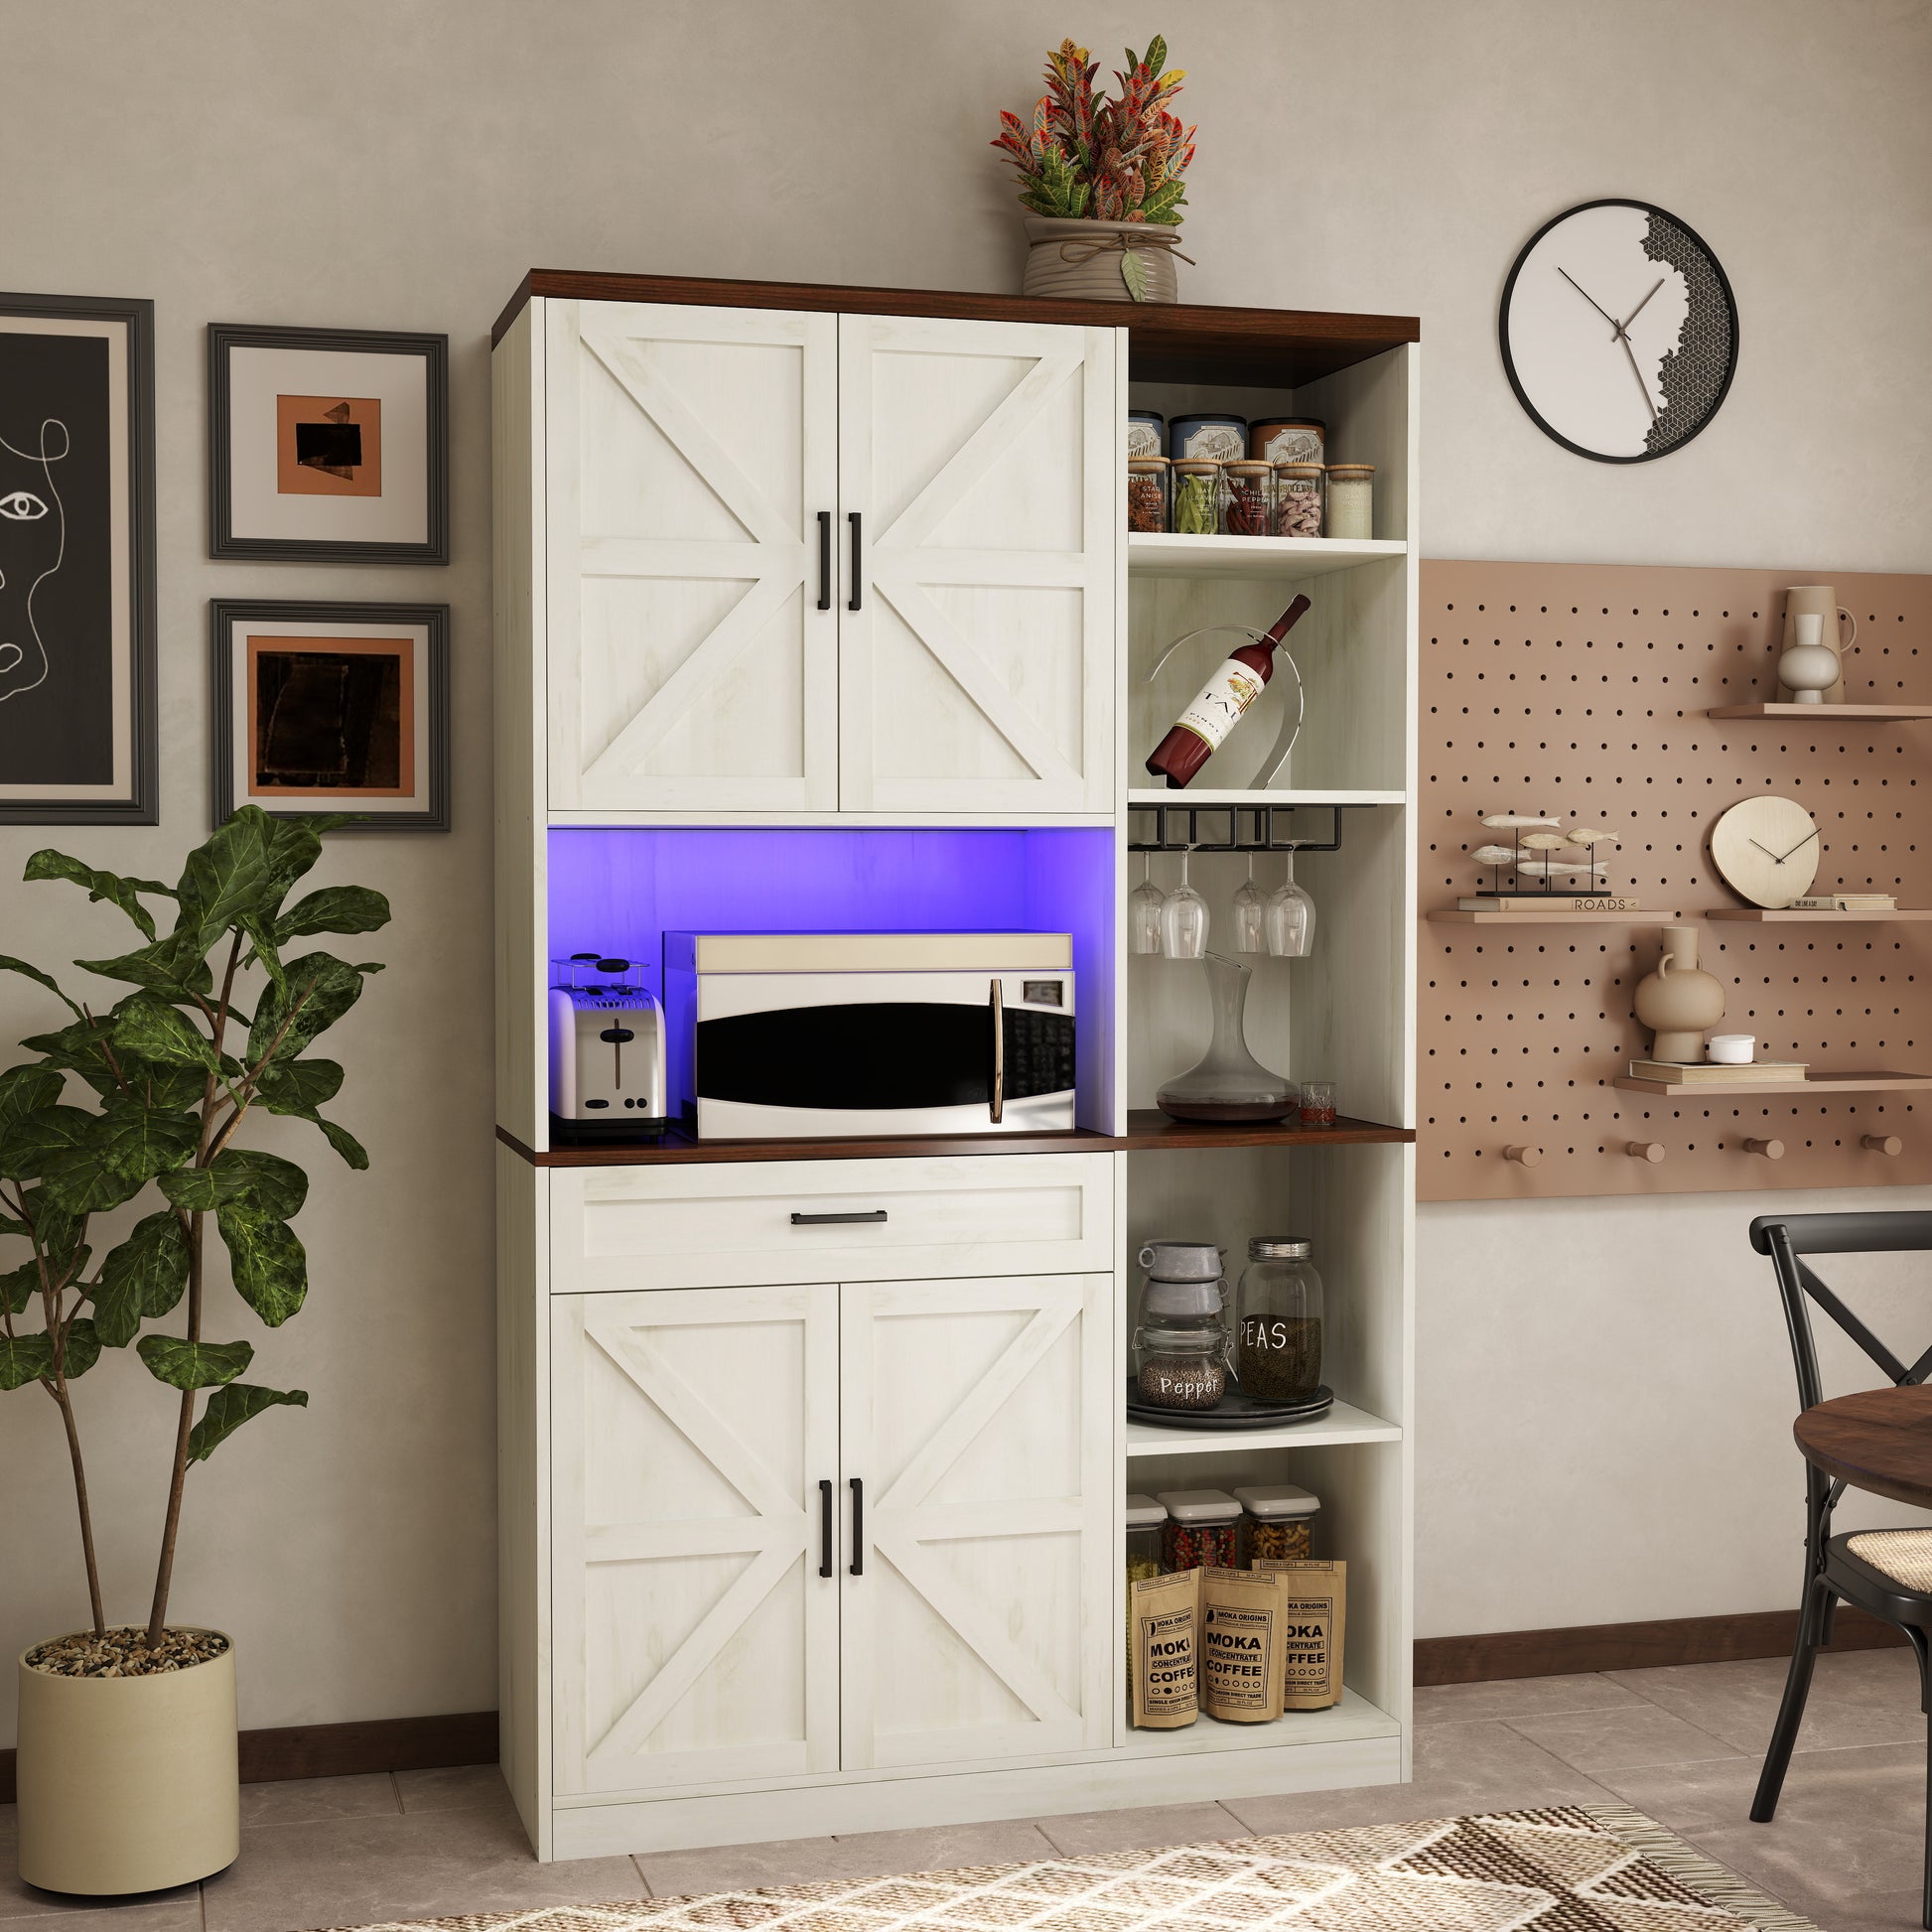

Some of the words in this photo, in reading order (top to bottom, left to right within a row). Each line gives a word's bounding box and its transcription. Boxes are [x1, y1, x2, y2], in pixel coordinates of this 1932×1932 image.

[1575, 898, 1626, 910] ROADS
[1240, 1320, 1287, 1349] PEAS
[1161, 1377, 1218, 1400] Pepper
[1218, 1610, 1238, 1620] MOKA
[1238, 1613, 1268, 1622] ORIGINS
[1287, 1624, 1323, 1638] OKA
[1206, 1631, 1262, 1650] MOKA
[1152, 1654, 1191, 1669] CONCENTRA
[1210, 1648, 1259, 1661] CONCENTRATE
[1288, 1653, 1325, 1664] FFEE
[1205, 1659, 1263, 1677] COFFEE
